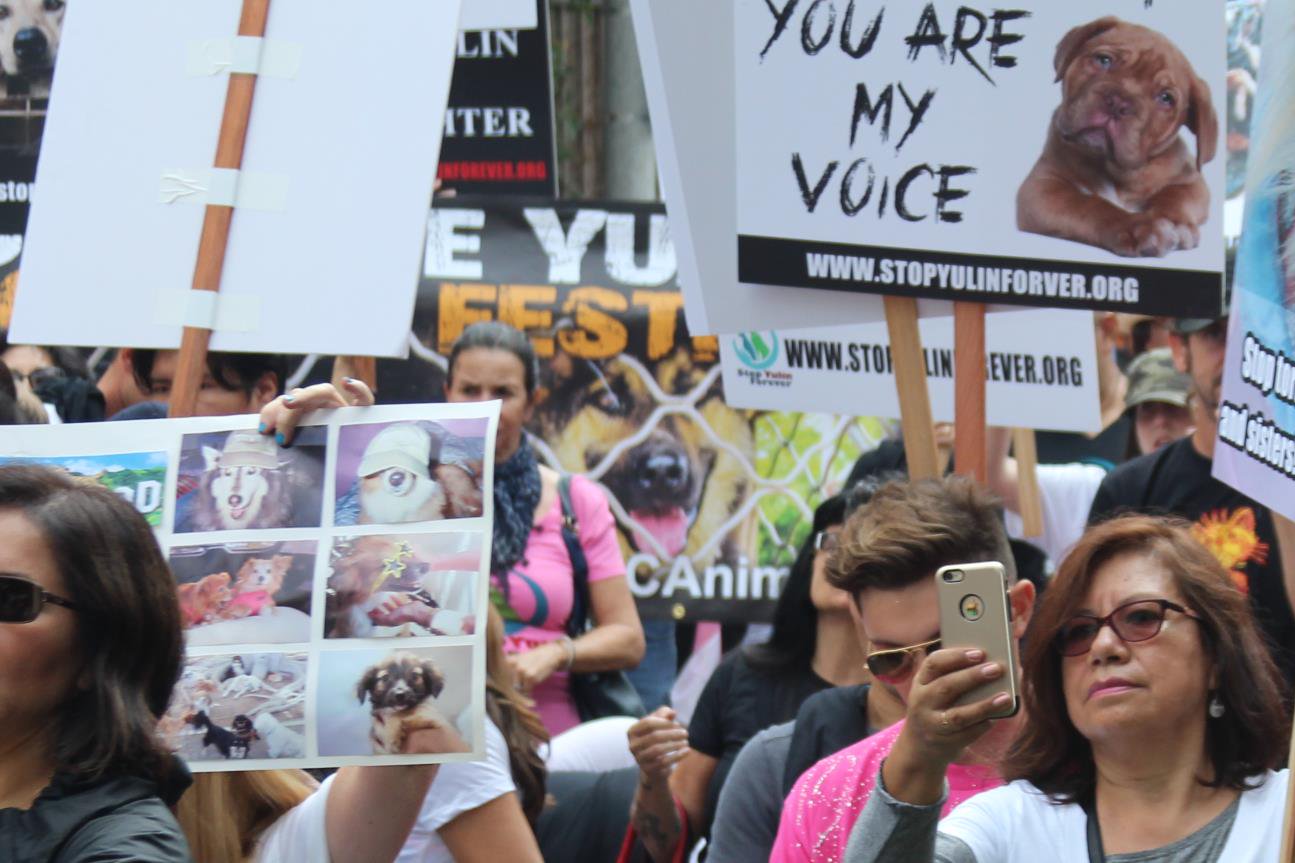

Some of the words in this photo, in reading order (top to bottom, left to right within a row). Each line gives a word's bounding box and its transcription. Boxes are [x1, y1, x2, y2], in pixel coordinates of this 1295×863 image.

[759, 0, 886, 60] YOU
[904, 2, 1032, 87] ARE
[850, 82, 938, 158] MY
[791, 152, 979, 224] VOICE
[523, 208, 679, 287] YU
[806, 251, 1140, 303] WWW.STOPYULINFORVER.ORG
[784, 338, 1084, 388] WWW.STOLINEVER.ORG
[1242, 333, 1276, 396] Stop
[1218, 401, 1249, 450] and
